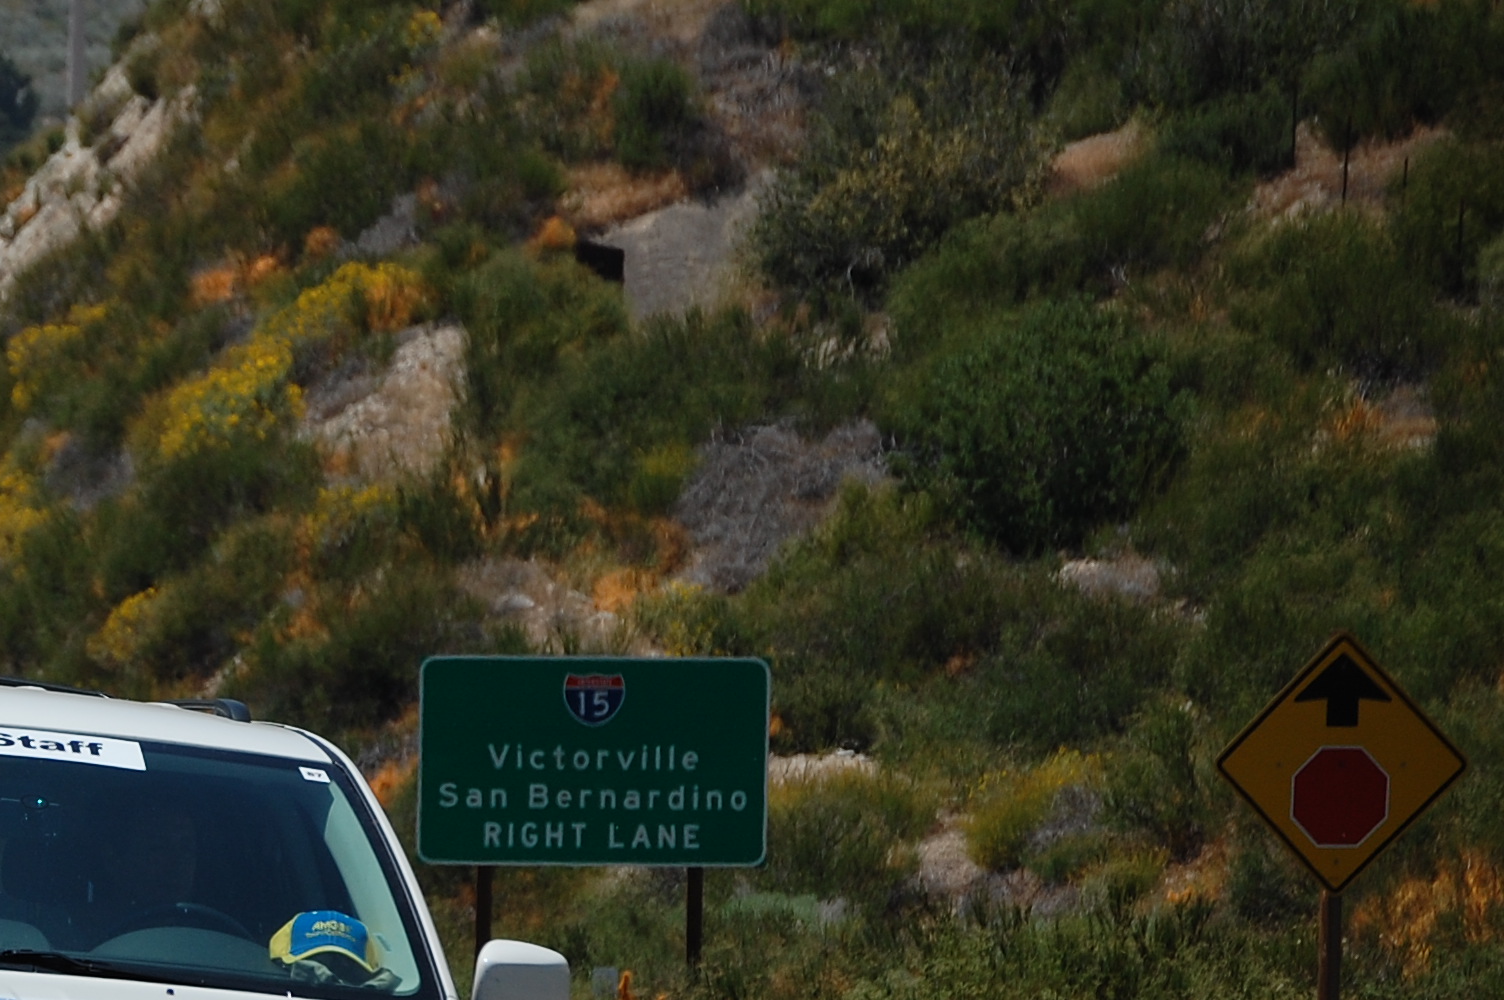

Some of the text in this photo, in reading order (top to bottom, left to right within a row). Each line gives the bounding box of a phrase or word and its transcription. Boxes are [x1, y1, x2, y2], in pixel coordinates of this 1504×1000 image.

[578, 691, 610, 717] 15
[488, 743, 699, 771] Victorville
[438, 782, 749, 812] San Bernardino
[483, 821, 702, 850] RIGHT LANE
